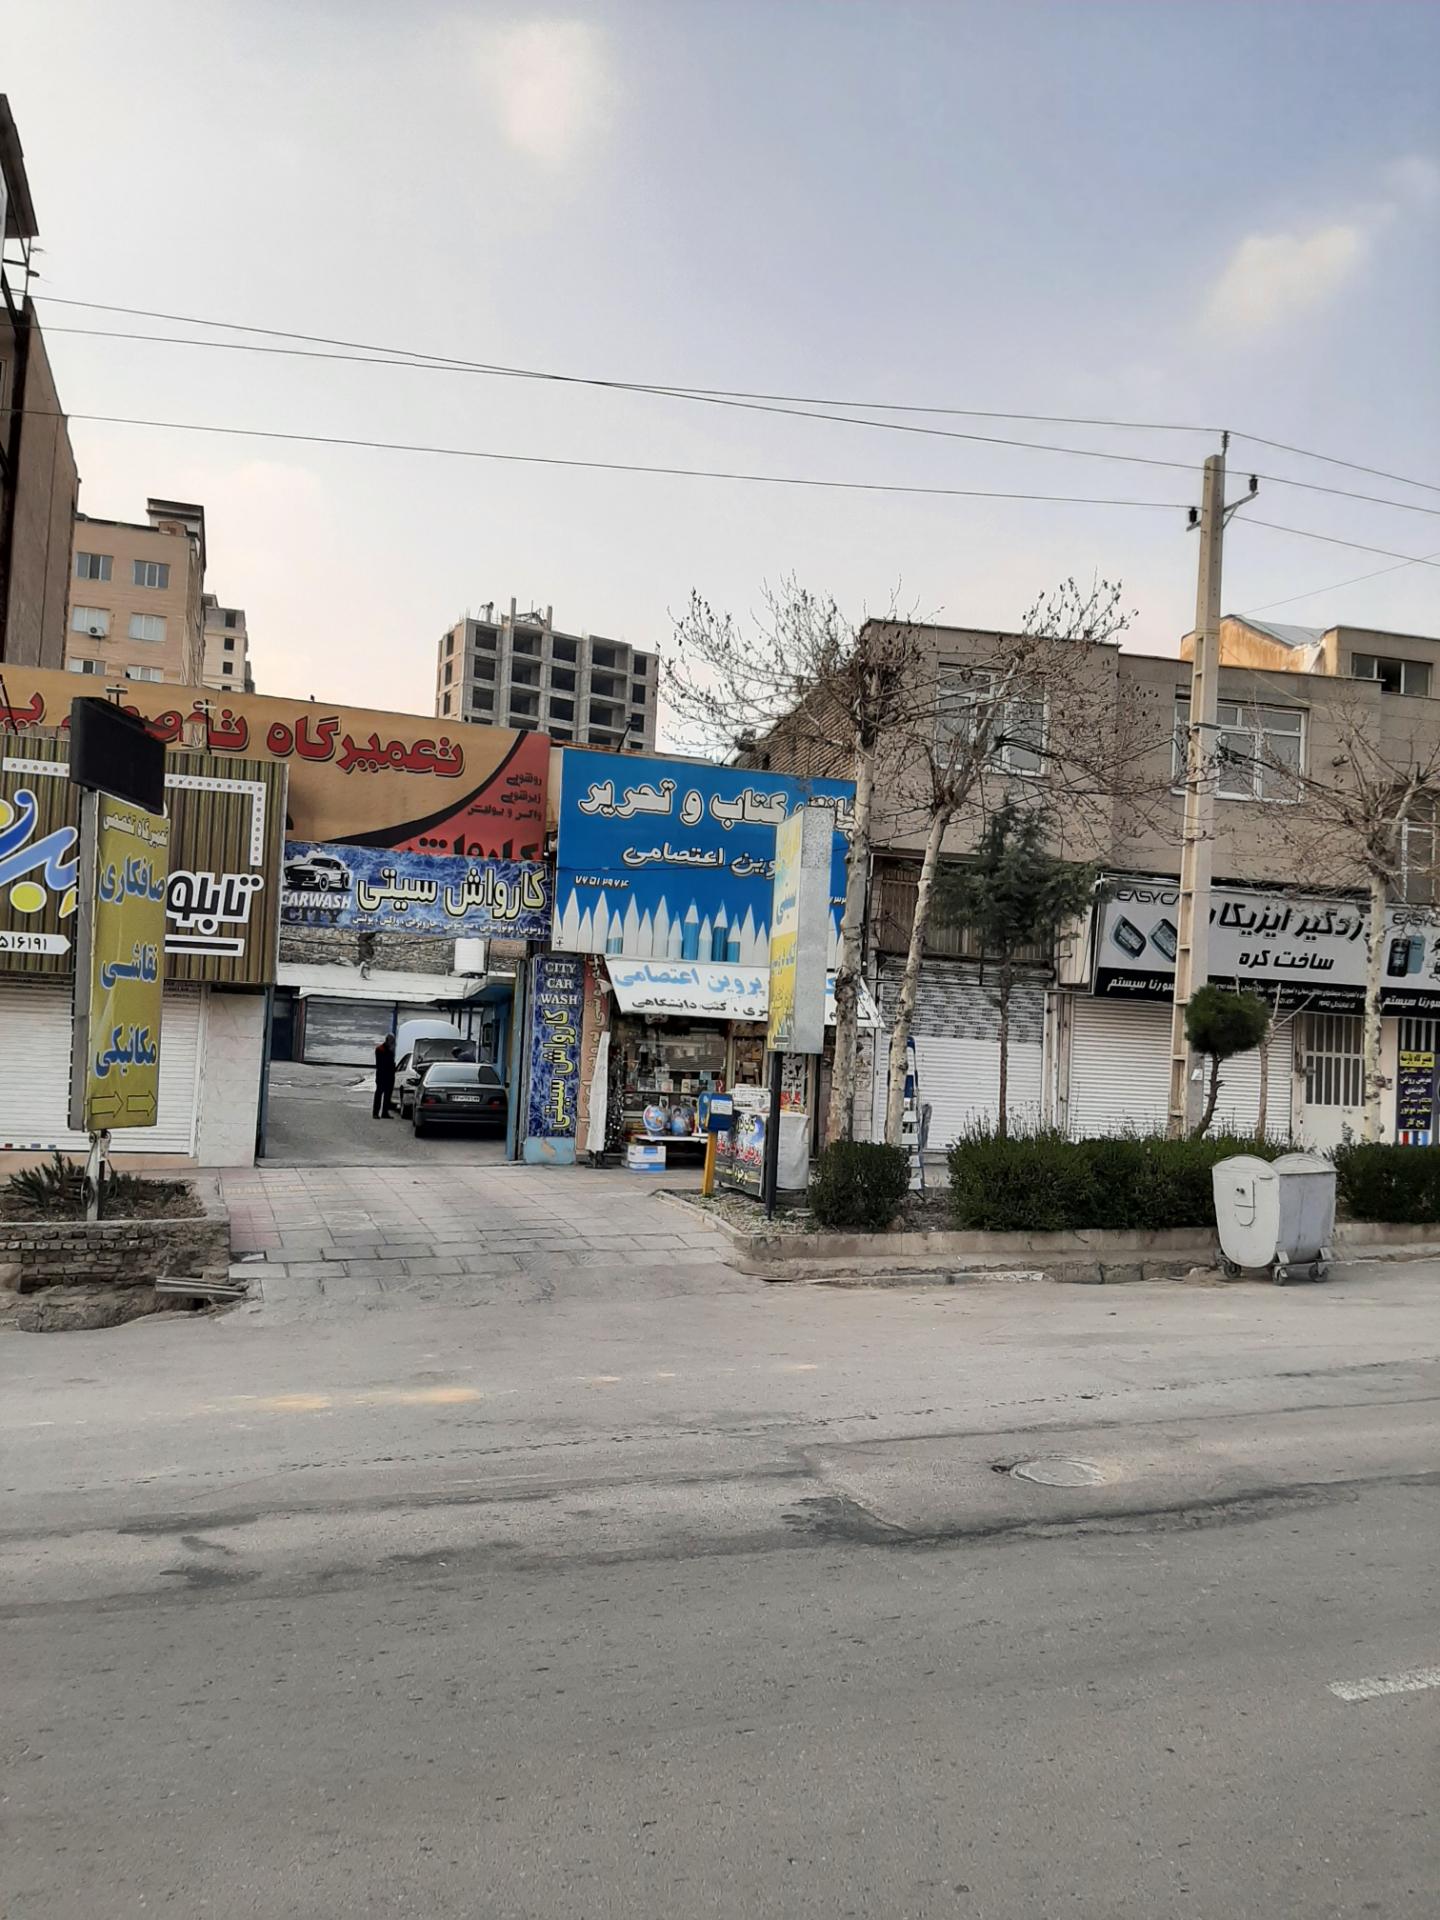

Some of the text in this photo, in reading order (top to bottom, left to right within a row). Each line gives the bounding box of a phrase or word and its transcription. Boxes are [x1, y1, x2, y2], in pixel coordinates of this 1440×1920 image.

[266, 716, 464, 776] تعمیرگاه
[578, 779, 677, 820] تحریر
[680, 790, 703, 826] و
[711, 789, 788, 829] کتاب
[621, 842, 726, 867] اعتصامی
[99, 854, 165, 904] صافکاری
[357, 866, 546, 920] کارواش سیتی
[281, 889, 353, 909] CARWASH
[102, 940, 159, 990] نقاشی
[545, 962, 576, 974] CITY
[1238, 949, 1335, 970] ساخت کره
[540, 994, 578, 1006] WASH
[547, 978, 574, 989] CAR
[614, 963, 766, 1000] پروین اعتصامی
[1106, 976, 1147, 992] سیستم
[1383, 995, 1417, 1009] سیستم
[95, 1024, 158, 1079] مکانیکی
[543, 1009, 577, 1075] کارواش
[545, 1078, 571, 1129] سیتی
